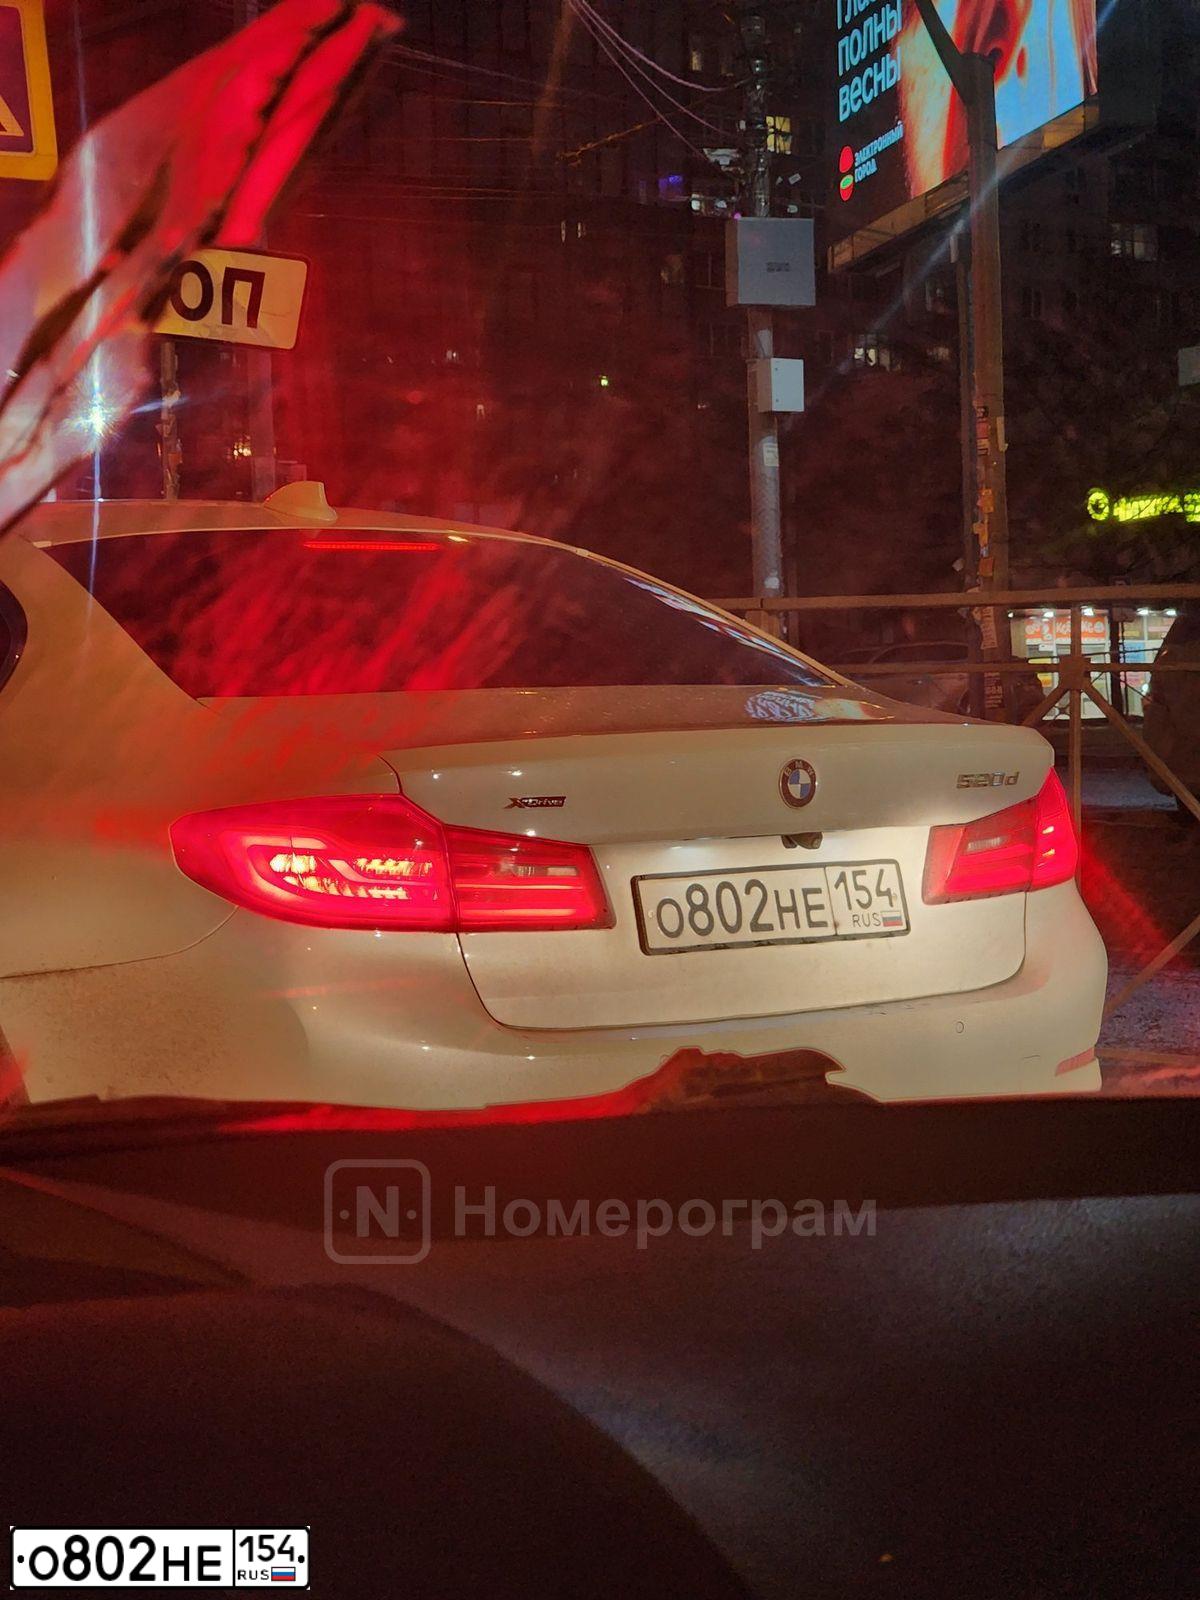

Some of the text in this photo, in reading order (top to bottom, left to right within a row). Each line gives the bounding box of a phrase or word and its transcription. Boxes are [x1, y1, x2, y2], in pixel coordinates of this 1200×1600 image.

[839, 46, 902, 122] весны
[170, 260, 266, 329] ОП
[956, 771, 1020, 789] 520d
[834, 868, 895, 911] 154
[852, 911, 882, 928] RUS
